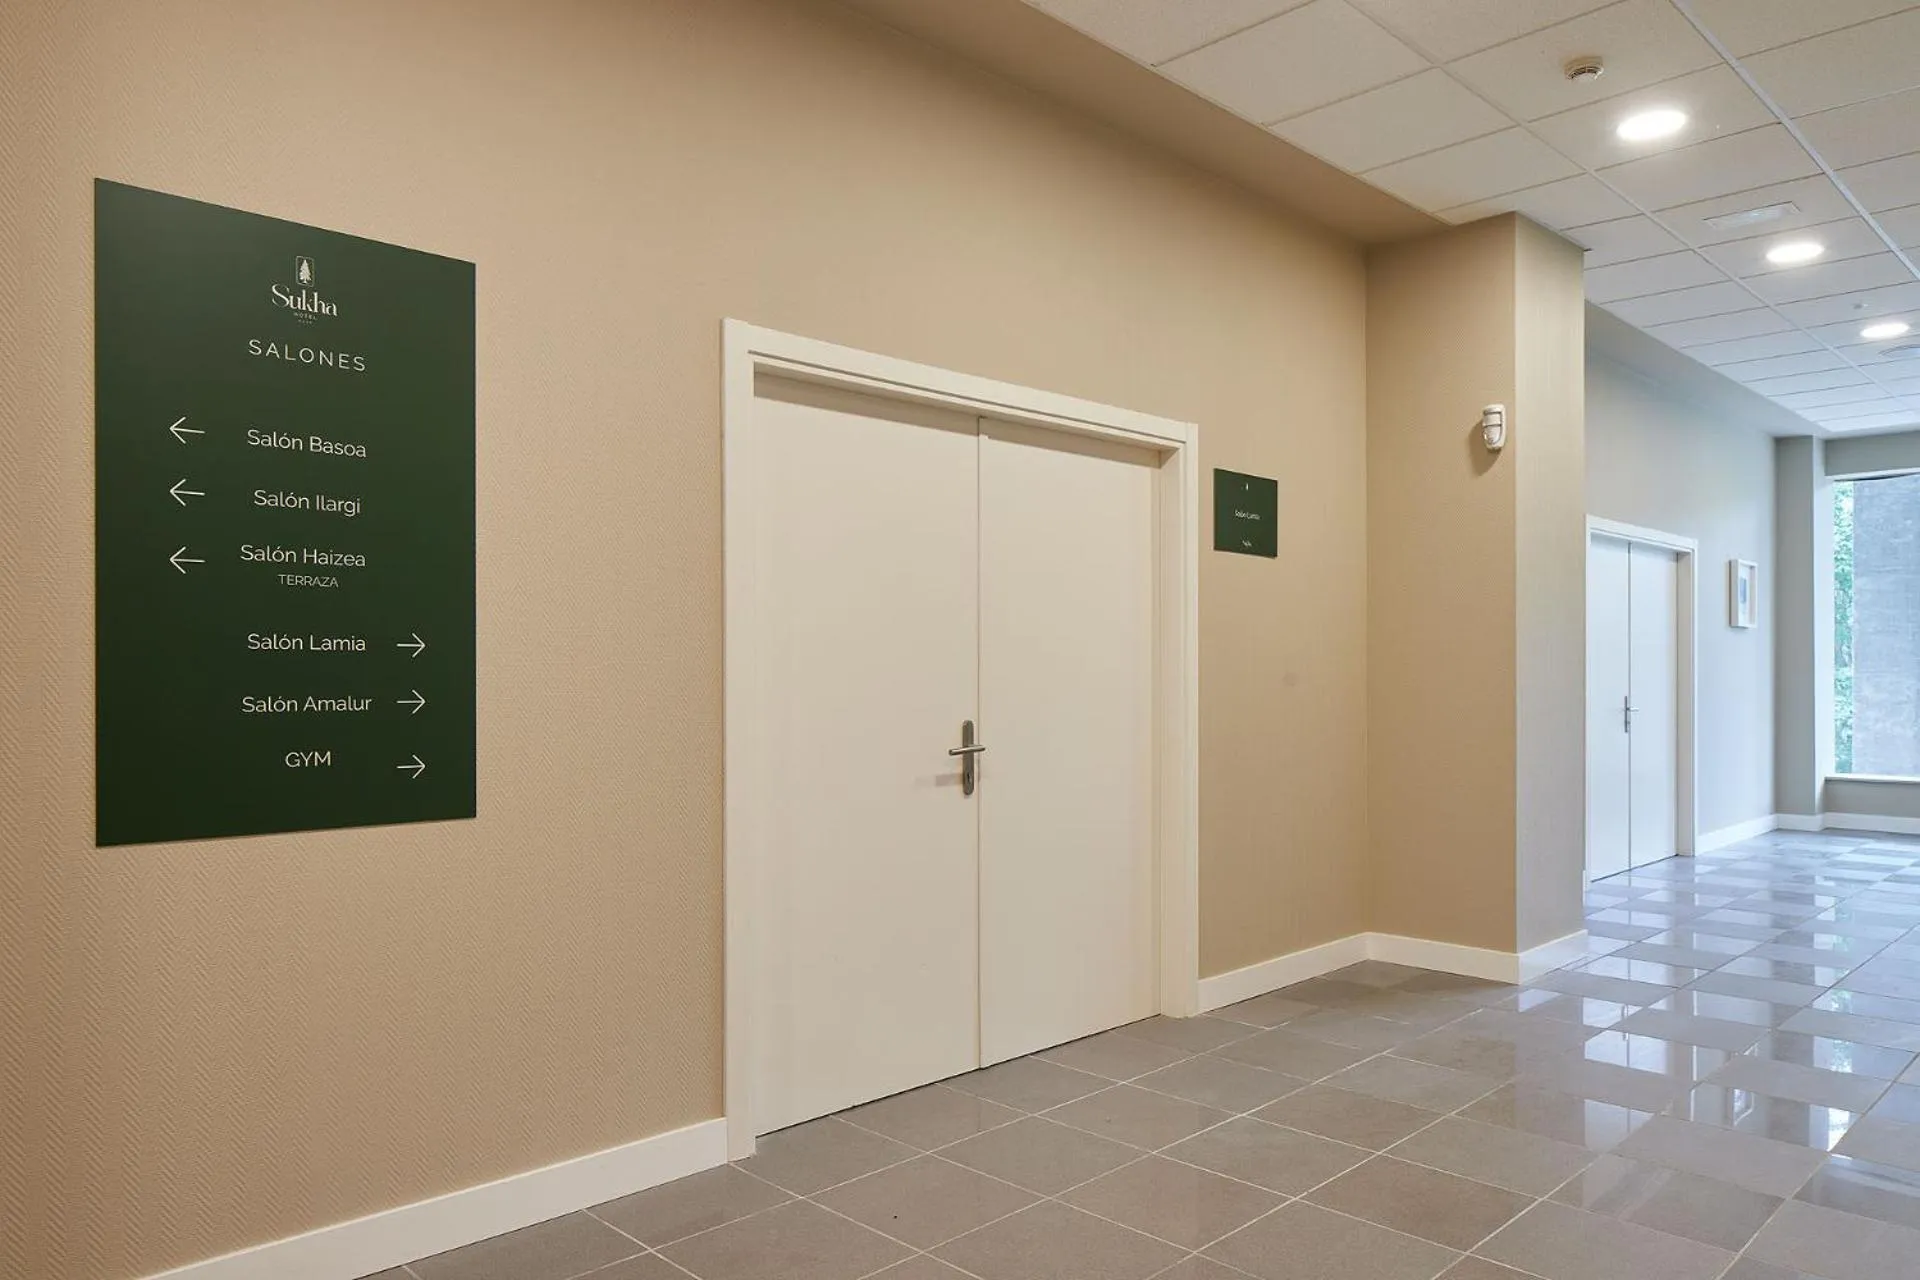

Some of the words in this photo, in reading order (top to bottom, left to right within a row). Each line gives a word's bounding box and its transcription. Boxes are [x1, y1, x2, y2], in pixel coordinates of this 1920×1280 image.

[271, 283, 338, 317] Sukha
[247, 338, 367, 372] SALONES
[247, 429, 303, 452] Salón
[309, 435, 367, 458] Basoa
[253, 489, 310, 510] Salón
[315, 494, 361, 517] Ilargi
[240, 544, 297, 563] Salón
[303, 547, 366, 567] Haizea
[277, 573, 339, 588] TERRAZA
[247, 632, 304, 651] Salón
[309, 634, 367, 652] Lamia
[241, 695, 298, 713] Salón
[303, 695, 373, 713] Amalur
[284, 751, 332, 768] GYM
